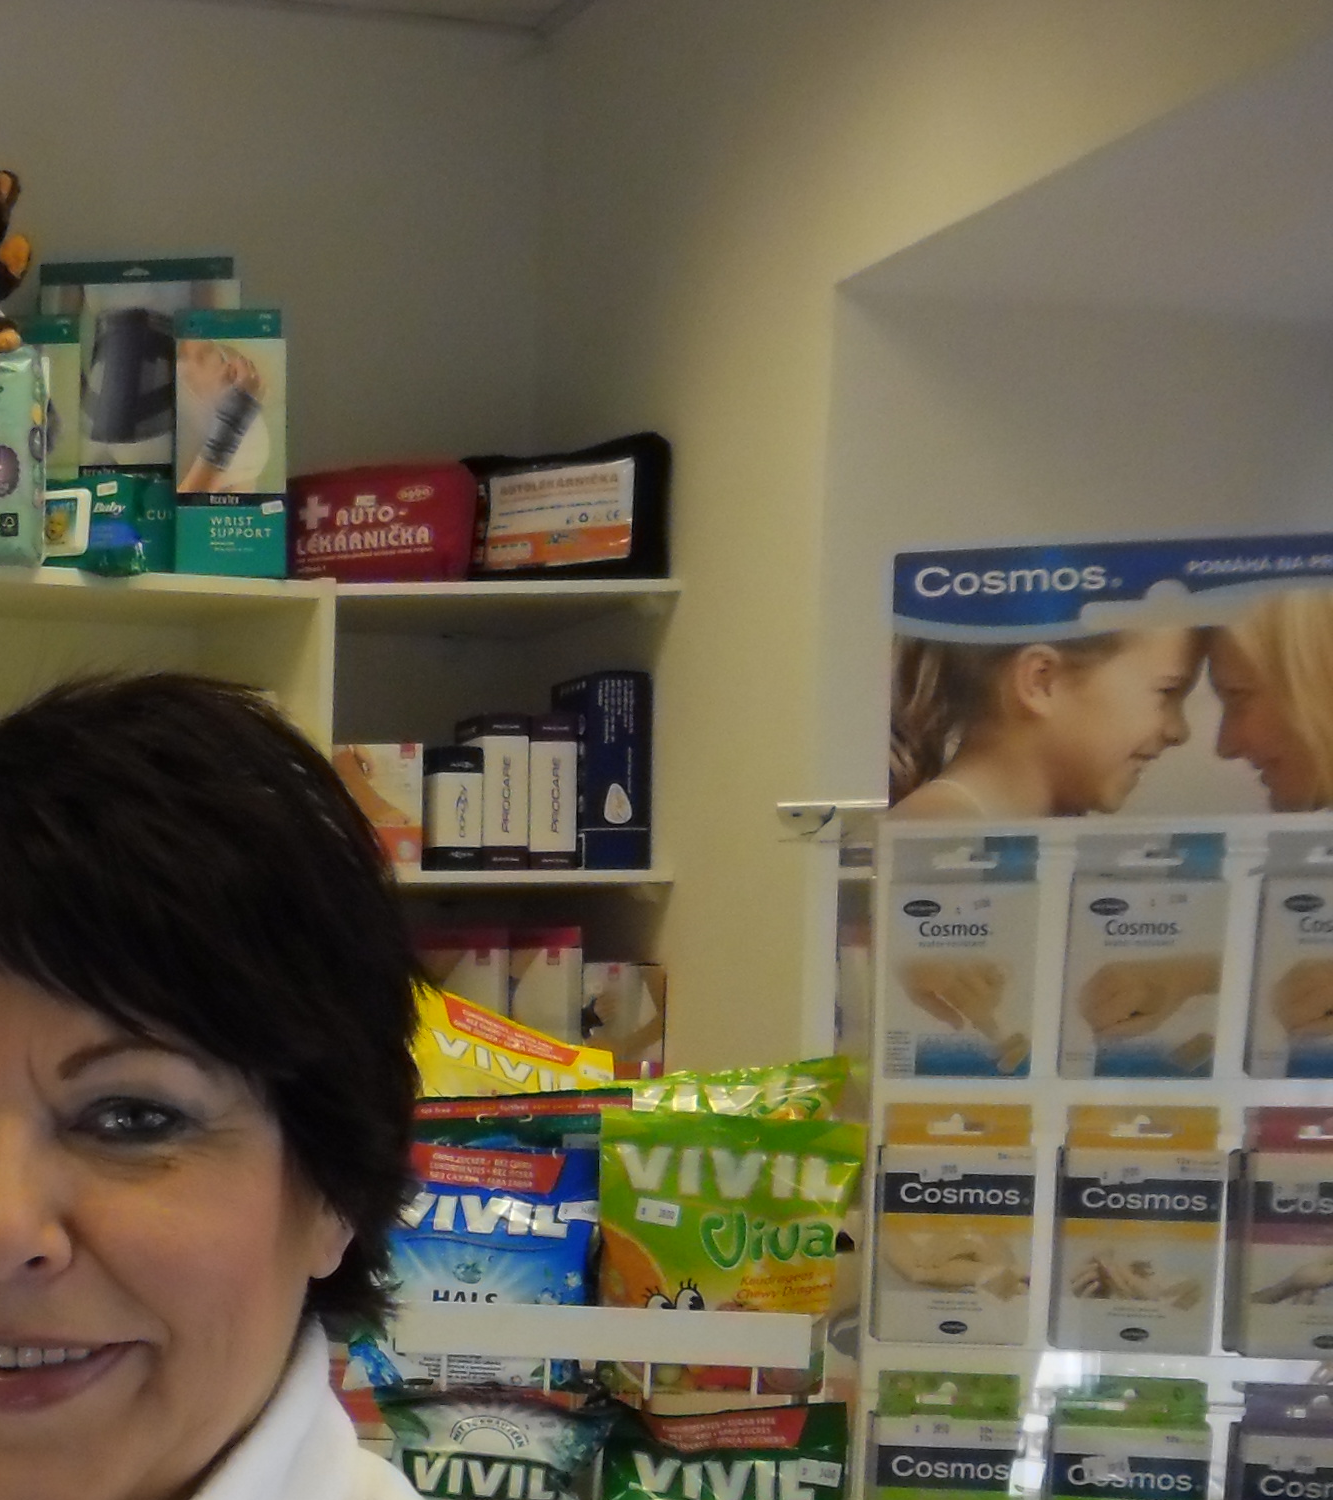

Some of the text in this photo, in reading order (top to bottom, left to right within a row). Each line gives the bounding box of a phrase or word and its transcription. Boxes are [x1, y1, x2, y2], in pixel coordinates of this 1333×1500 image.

[210, 516, 254, 527] WRIST
[210, 528, 272, 539] SUPPORT
[913, 564, 1109, 598] Cosmos
[501, 755, 512, 834] PROCARE
[550, 756, 561, 835] PROCARE
[918, 920, 989, 938] Cosmos
[1104, 919, 1180, 937] Cosmos
[1299, 917, 1333, 933] Cos
[618, 1143, 861, 1203] VIVIL
[899, 1182, 1021, 1206] Cosmos
[1081, 1186, 1208, 1212] Cosmos
[1270, 1190, 1333, 1214] Cos
[397, 1190, 580, 1239] VIVIL
[433, 1289, 499, 1304] HALS
[413, 1455, 560, 1500] VIVIL
[891, 1455, 1010, 1480] Cosmos
[1259, 1474, 1333, 1499] Cosm
